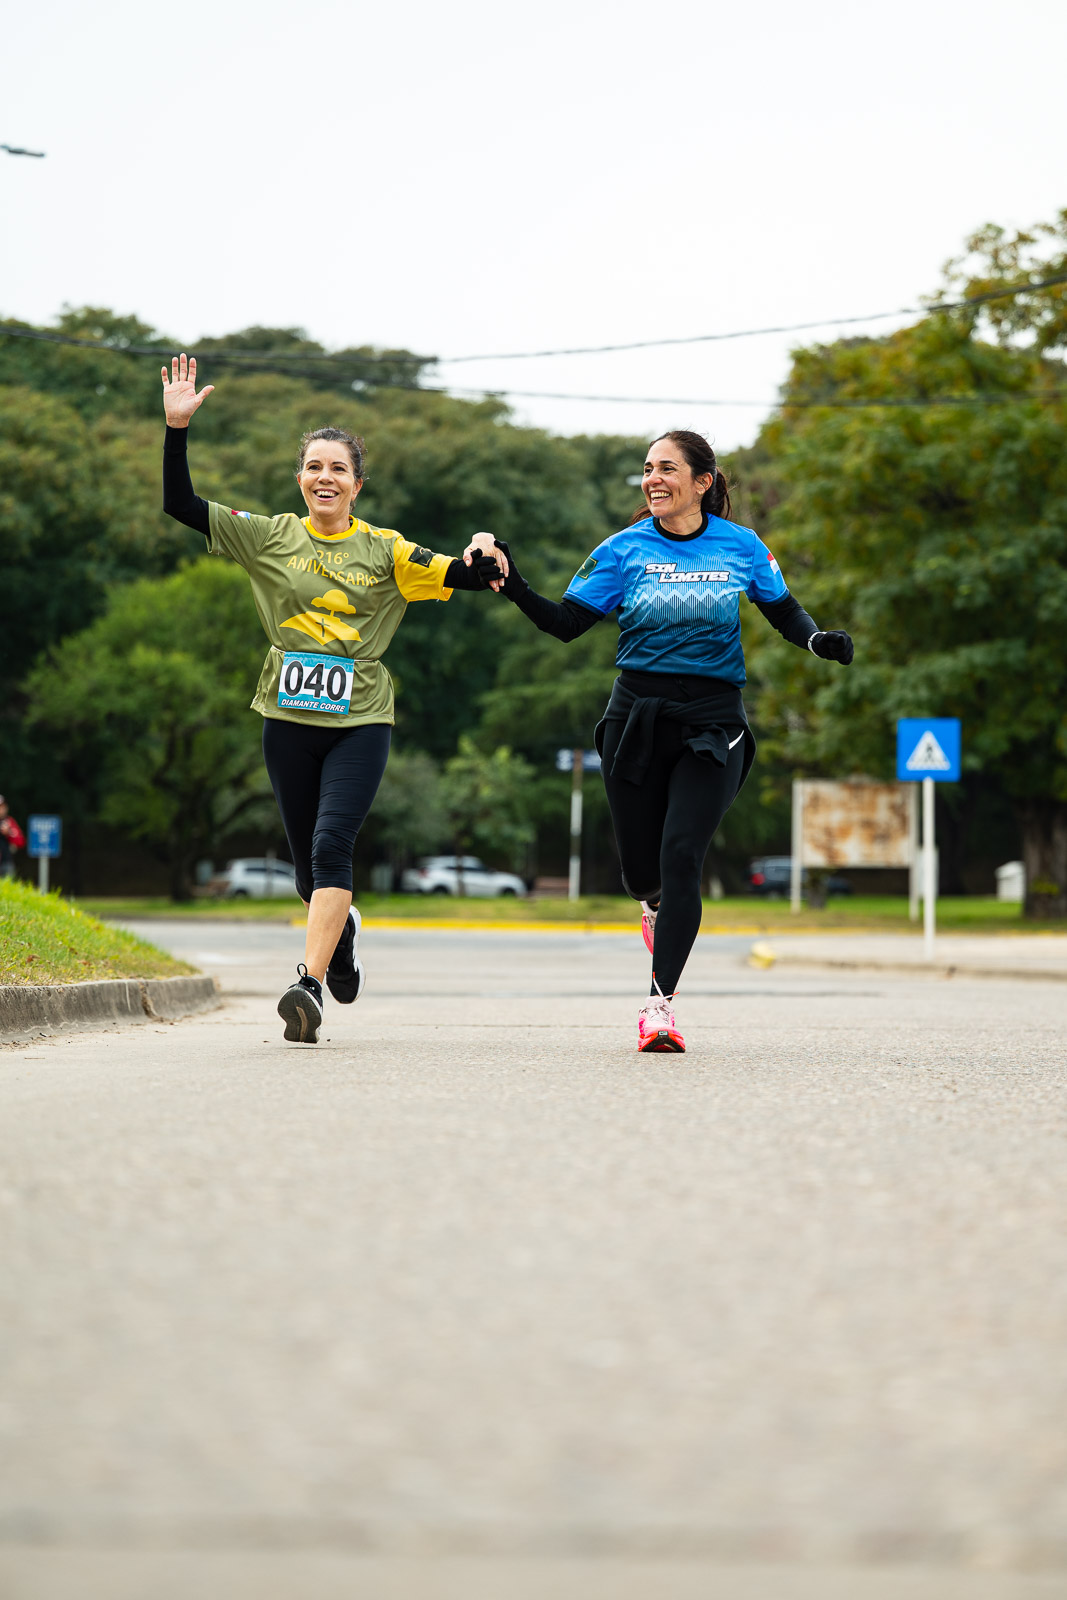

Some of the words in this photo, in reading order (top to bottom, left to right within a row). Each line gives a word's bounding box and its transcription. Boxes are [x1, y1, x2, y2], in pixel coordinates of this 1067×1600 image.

[645, 563, 677, 574] SIN
[658, 571, 730, 583] LIMITES
[284, 660, 347, 702] 040
[281, 699, 319, 709] DIAMANTE
[320, 703, 346, 712] CORRE
